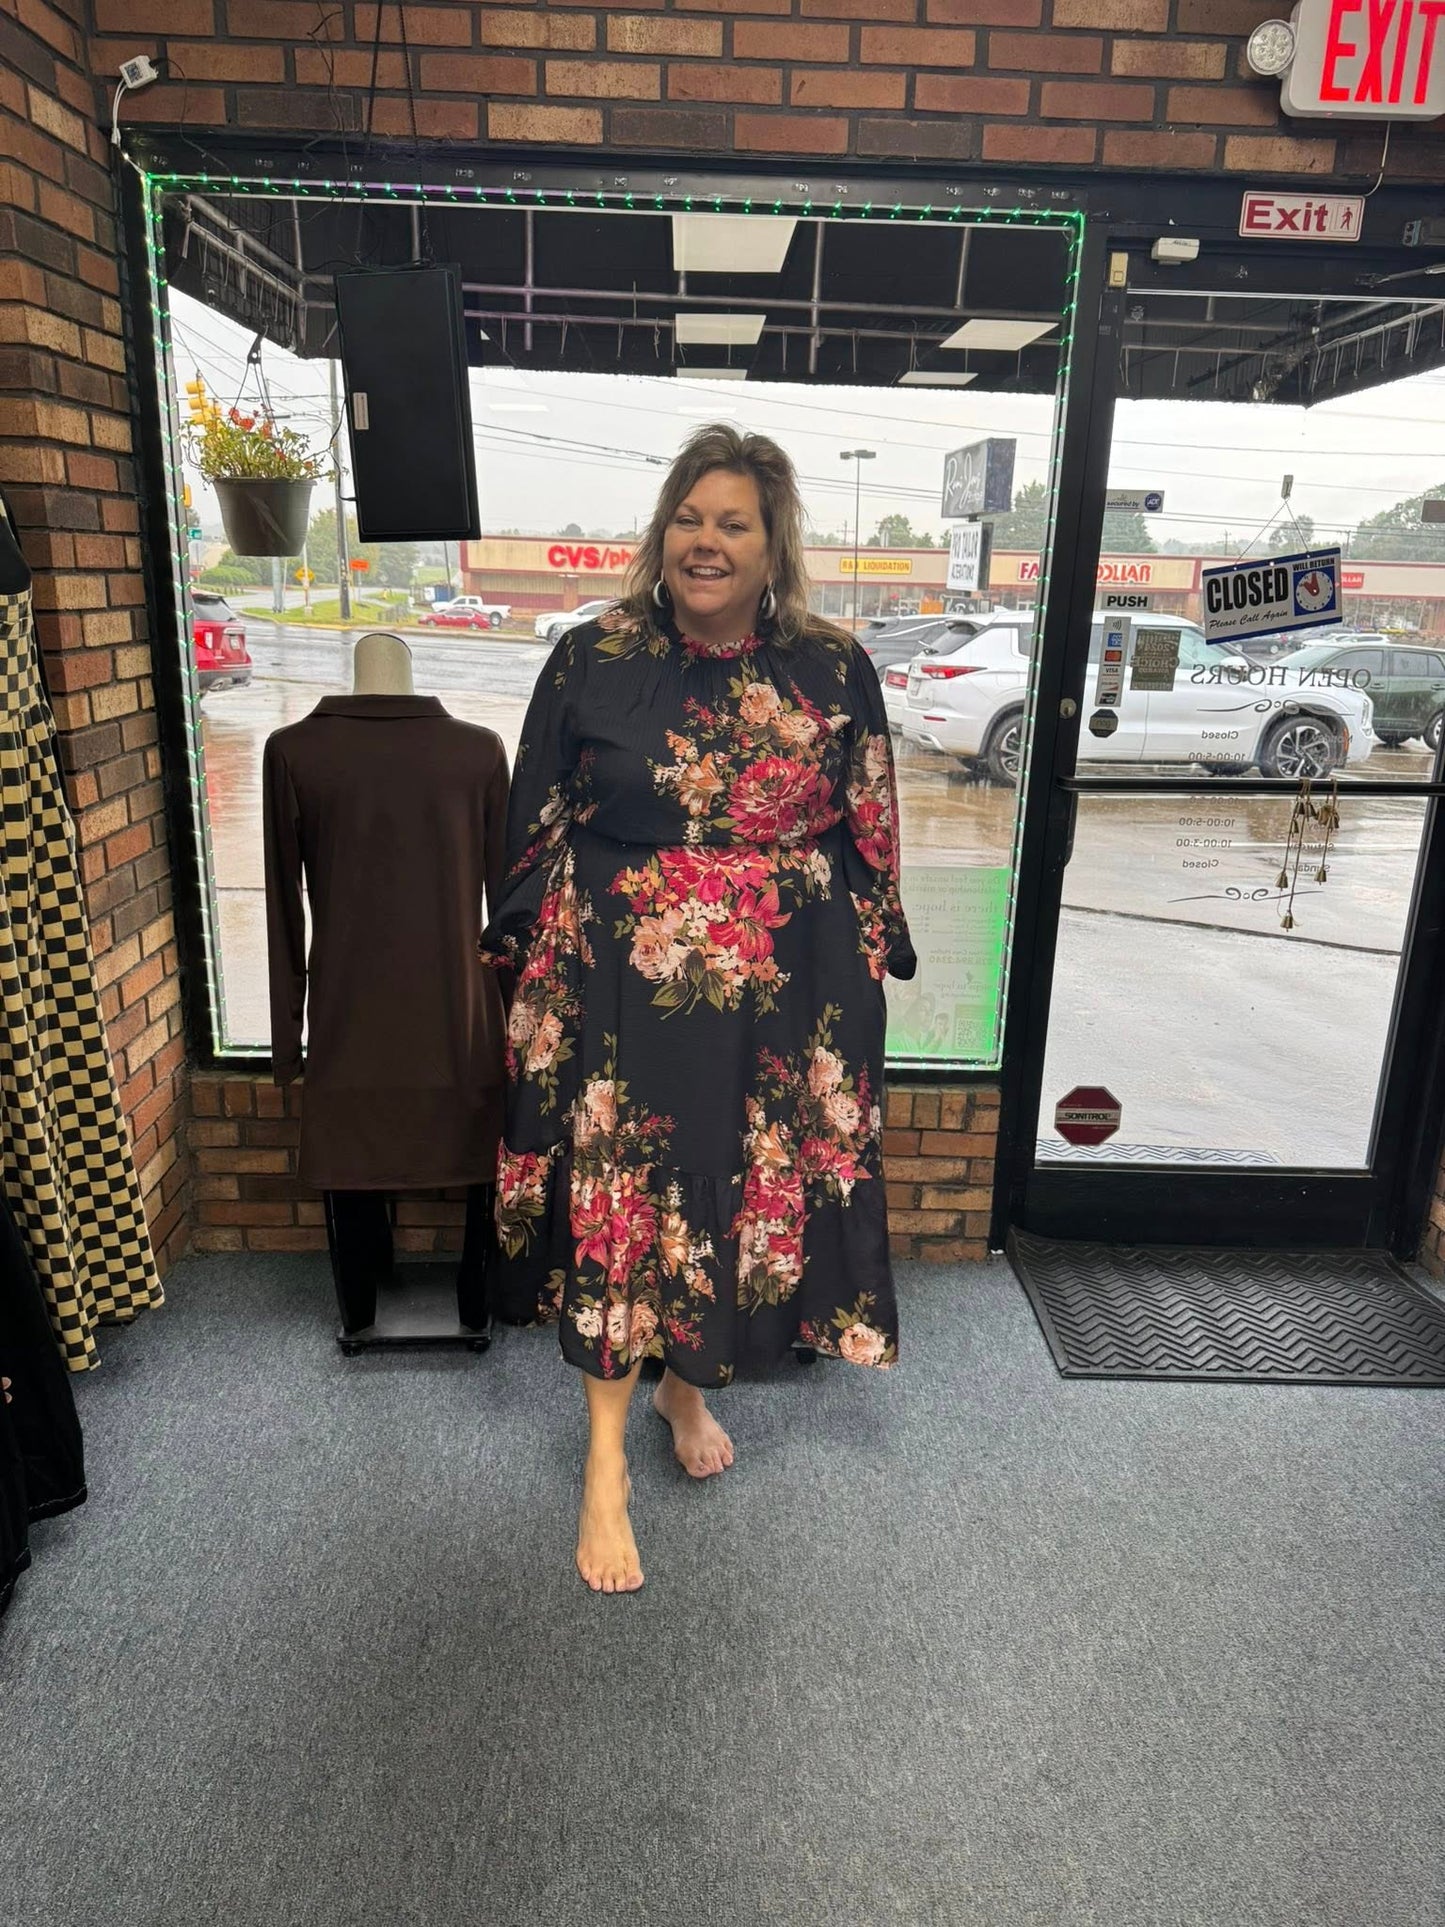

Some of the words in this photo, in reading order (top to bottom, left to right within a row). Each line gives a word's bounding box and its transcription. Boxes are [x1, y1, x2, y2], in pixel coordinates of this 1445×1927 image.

[1319, 0, 1445, 104] EXIT
[1245, 200, 1328, 232] Exit
[548, 545, 632, 569] CVS/ph
[864, 561, 909, 571] LIQUIDATION
[1292, 561, 1308, 571] WILL
[1309, 557, 1335, 569] RETURN
[1207, 567, 1289, 613] CLOSED
[1107, 595, 1148, 608] PUSH
[1209, 619, 1237, 629] Please
[1240, 613, 1259, 625] Call
[1260, 610, 1288, 622] Again
[1065, 1112, 1109, 1120] SONITROL
